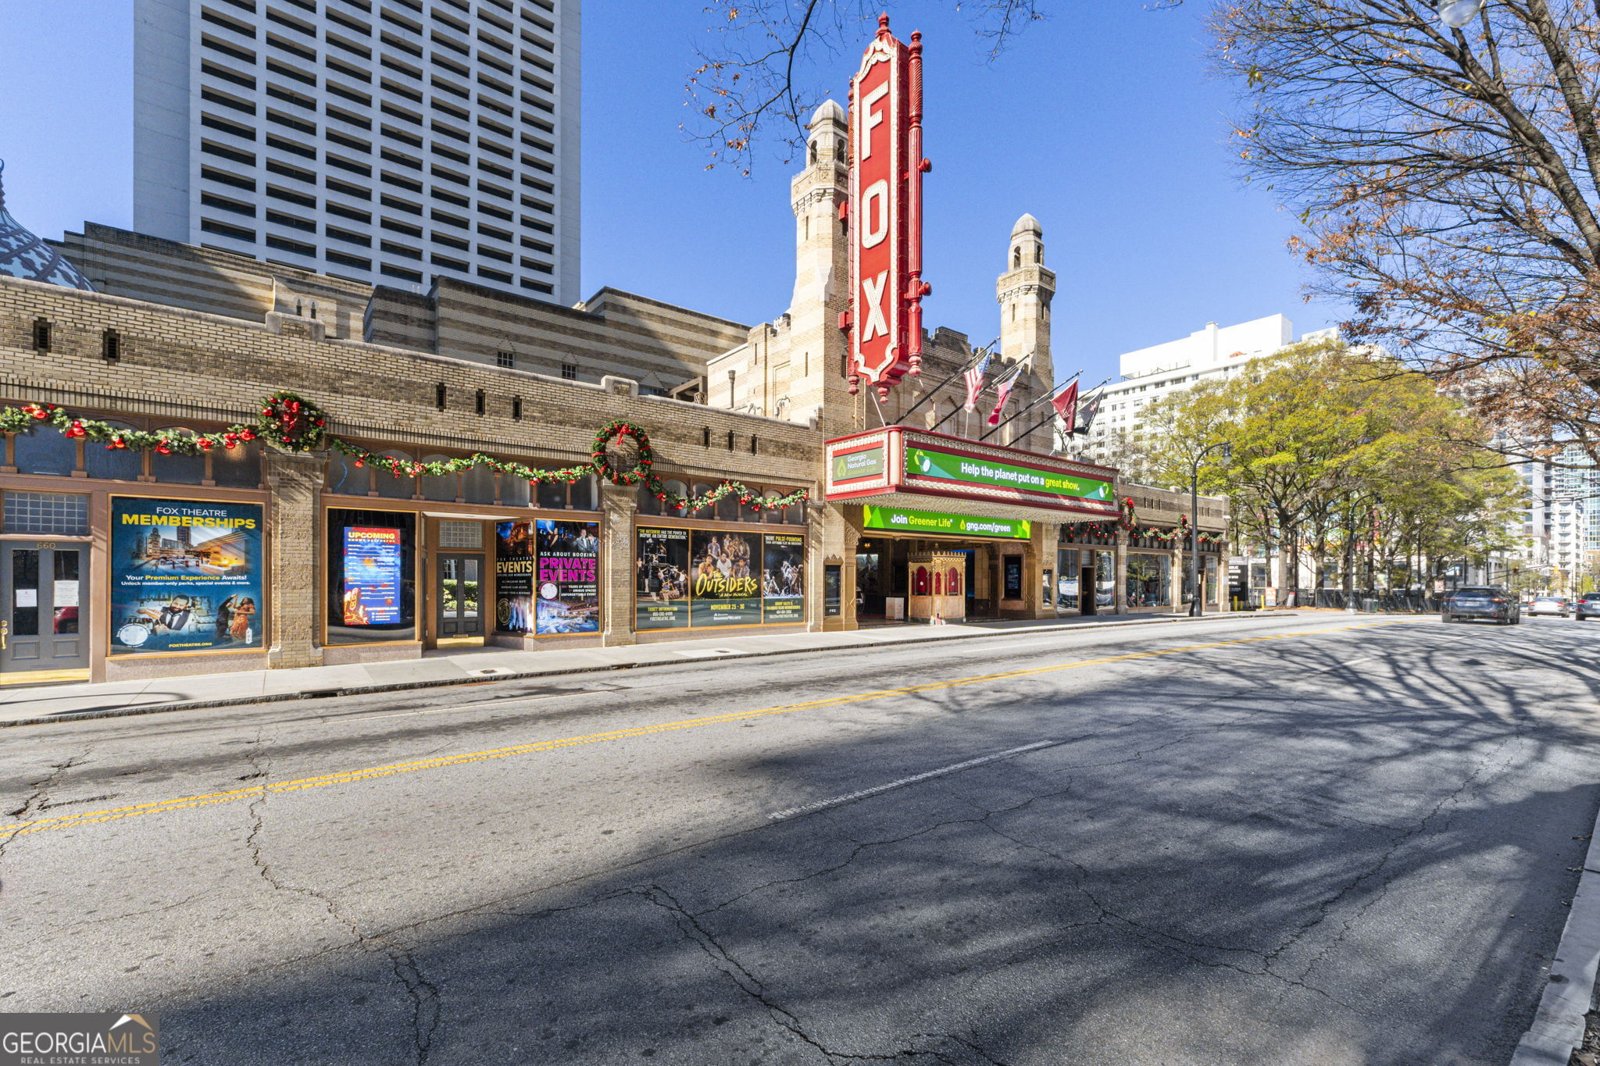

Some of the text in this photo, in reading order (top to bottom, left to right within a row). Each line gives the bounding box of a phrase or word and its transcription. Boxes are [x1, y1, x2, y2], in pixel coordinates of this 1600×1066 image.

[861, 79, 889, 343] FOX
[847, 454, 867, 463] Georgia
[847, 461, 866, 470] Natural
[961, 462, 1080, 491] Help the planet put on a great show.
[156, 507, 228, 517] FOX THEATRE
[121, 513, 257, 530] MEMBERSHIPS
[891, 514, 908, 525] Join
[908, 515, 938, 527] Greener
[966, 522, 1011, 533] gng.com/green
[348, 531, 396, 540] UPCOMING
[496, 561, 533, 573] EVENTS
[539, 557, 596, 570] PRIVATE
[539, 569, 596, 582] EVENTS
[695, 573, 758, 596] OUTSIDERS
